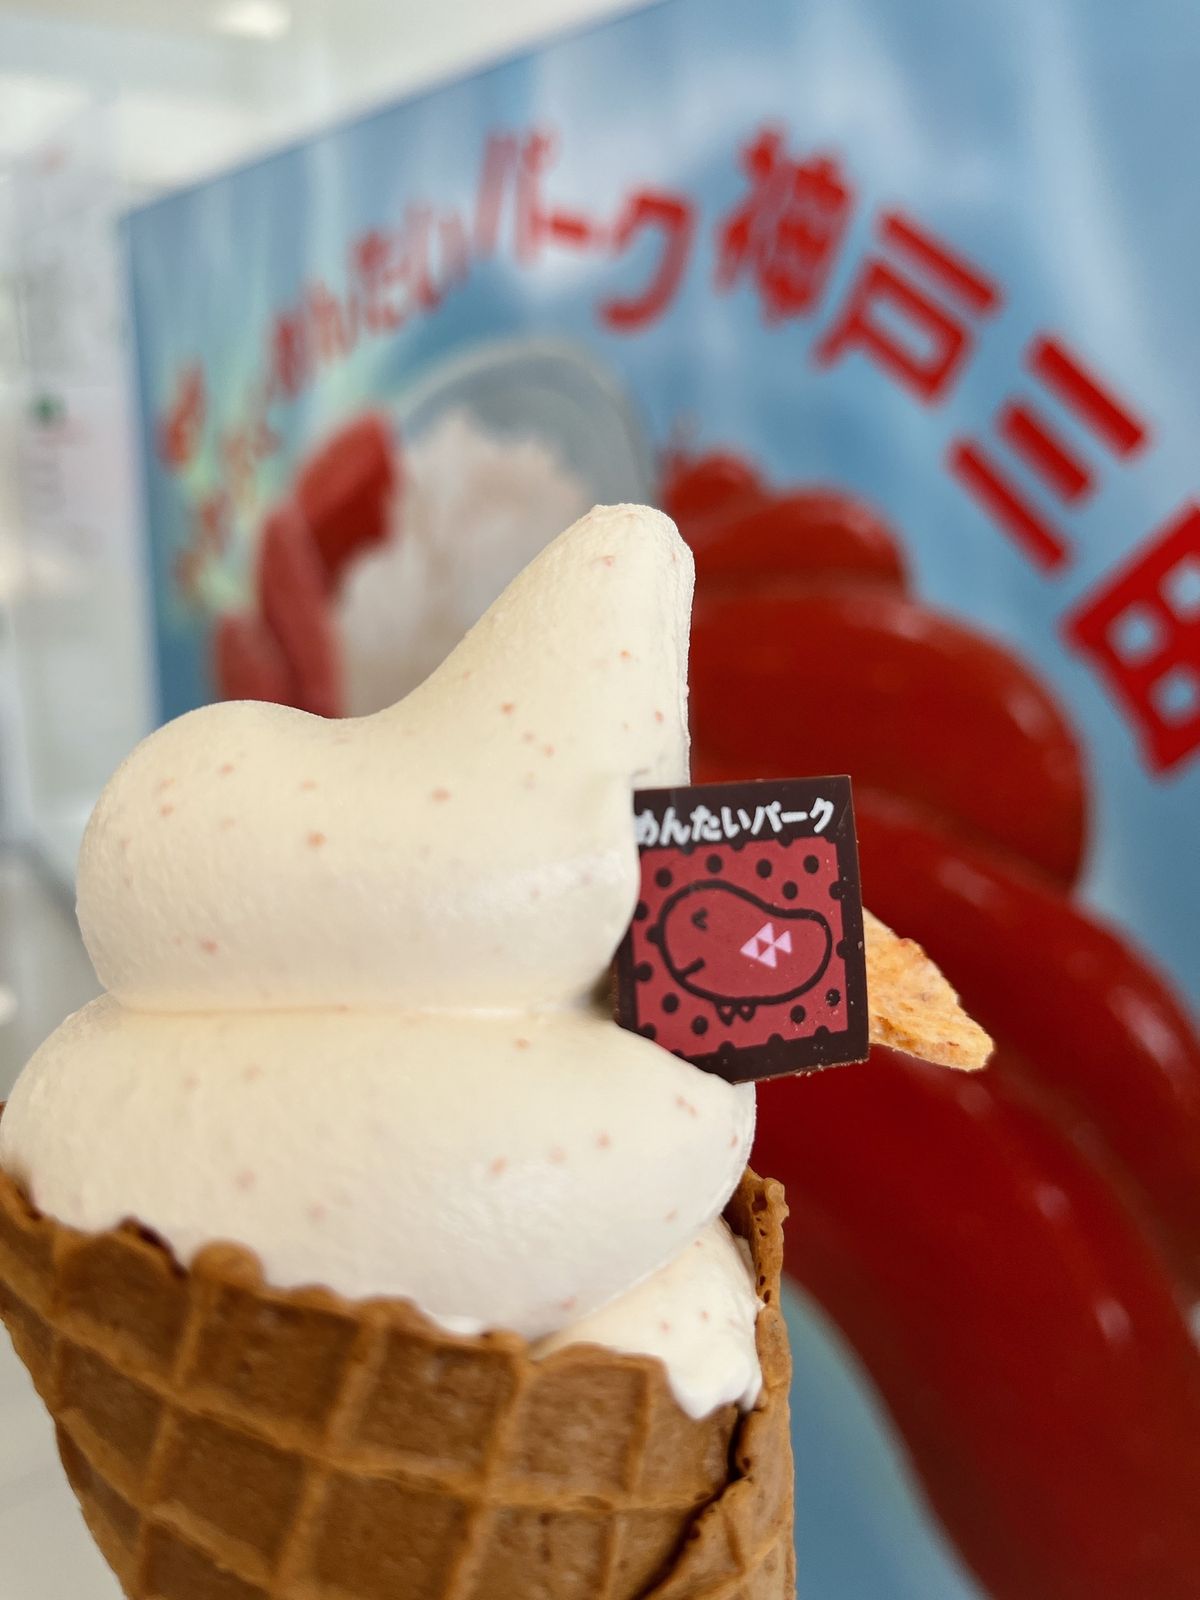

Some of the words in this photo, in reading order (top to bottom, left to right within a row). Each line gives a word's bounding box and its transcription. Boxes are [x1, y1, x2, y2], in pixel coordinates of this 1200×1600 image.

[633, 796, 835, 847] めんたいパーク
